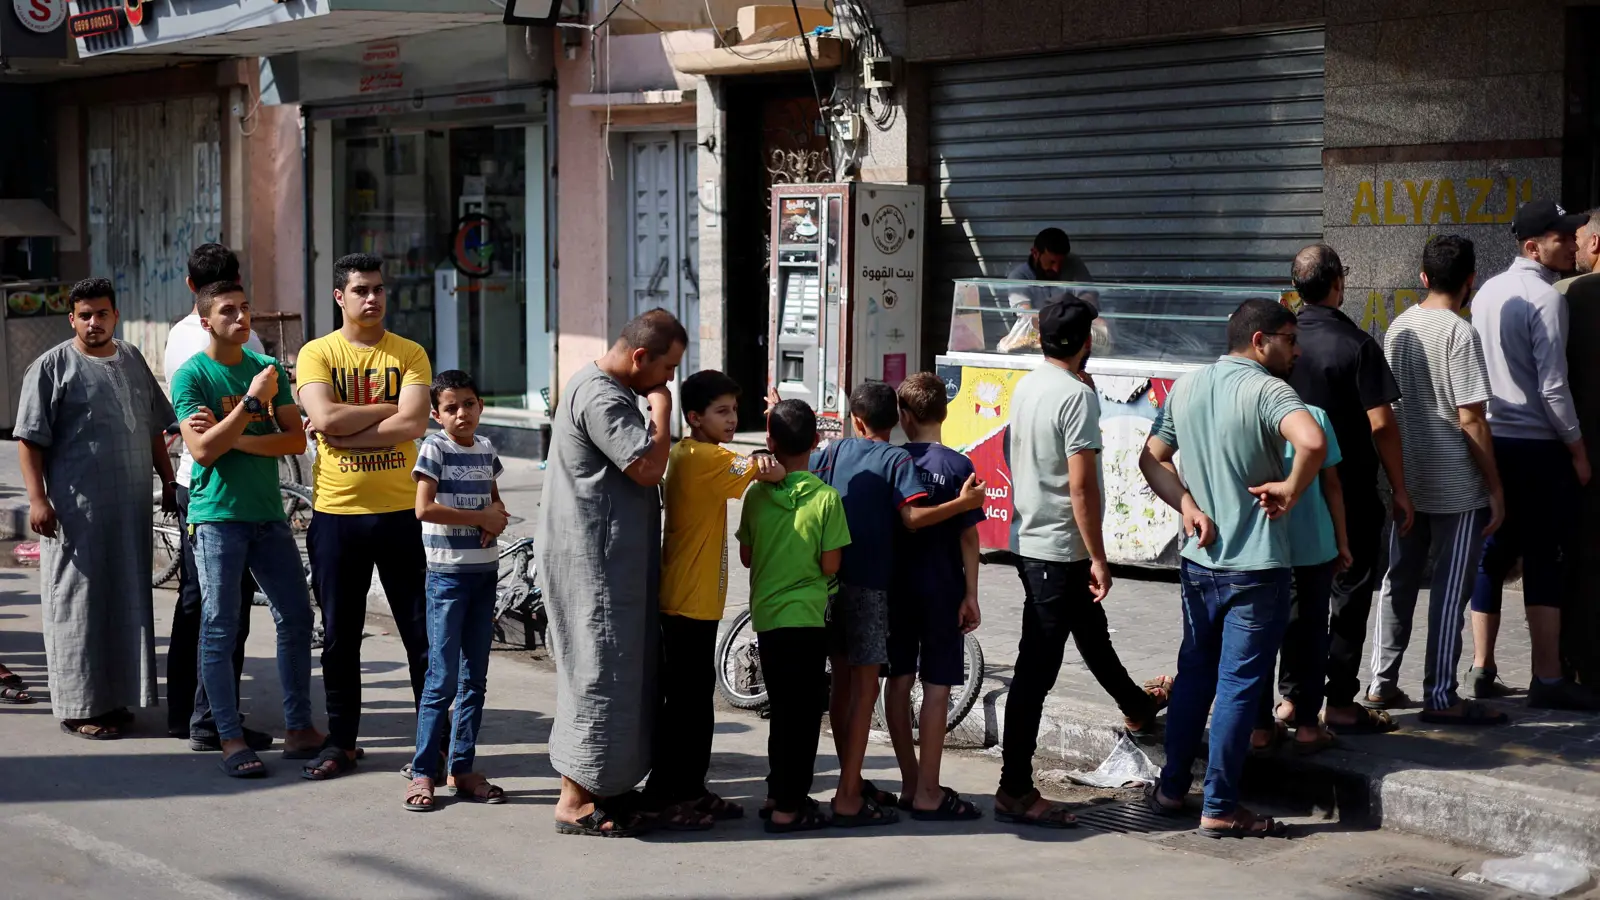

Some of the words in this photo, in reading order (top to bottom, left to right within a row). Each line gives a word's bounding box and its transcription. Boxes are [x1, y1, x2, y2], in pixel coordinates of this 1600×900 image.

[862, 266, 894, 281] القهوة
[896, 268, 914, 281] بيت
[340, 451, 406, 474] SUMMER
